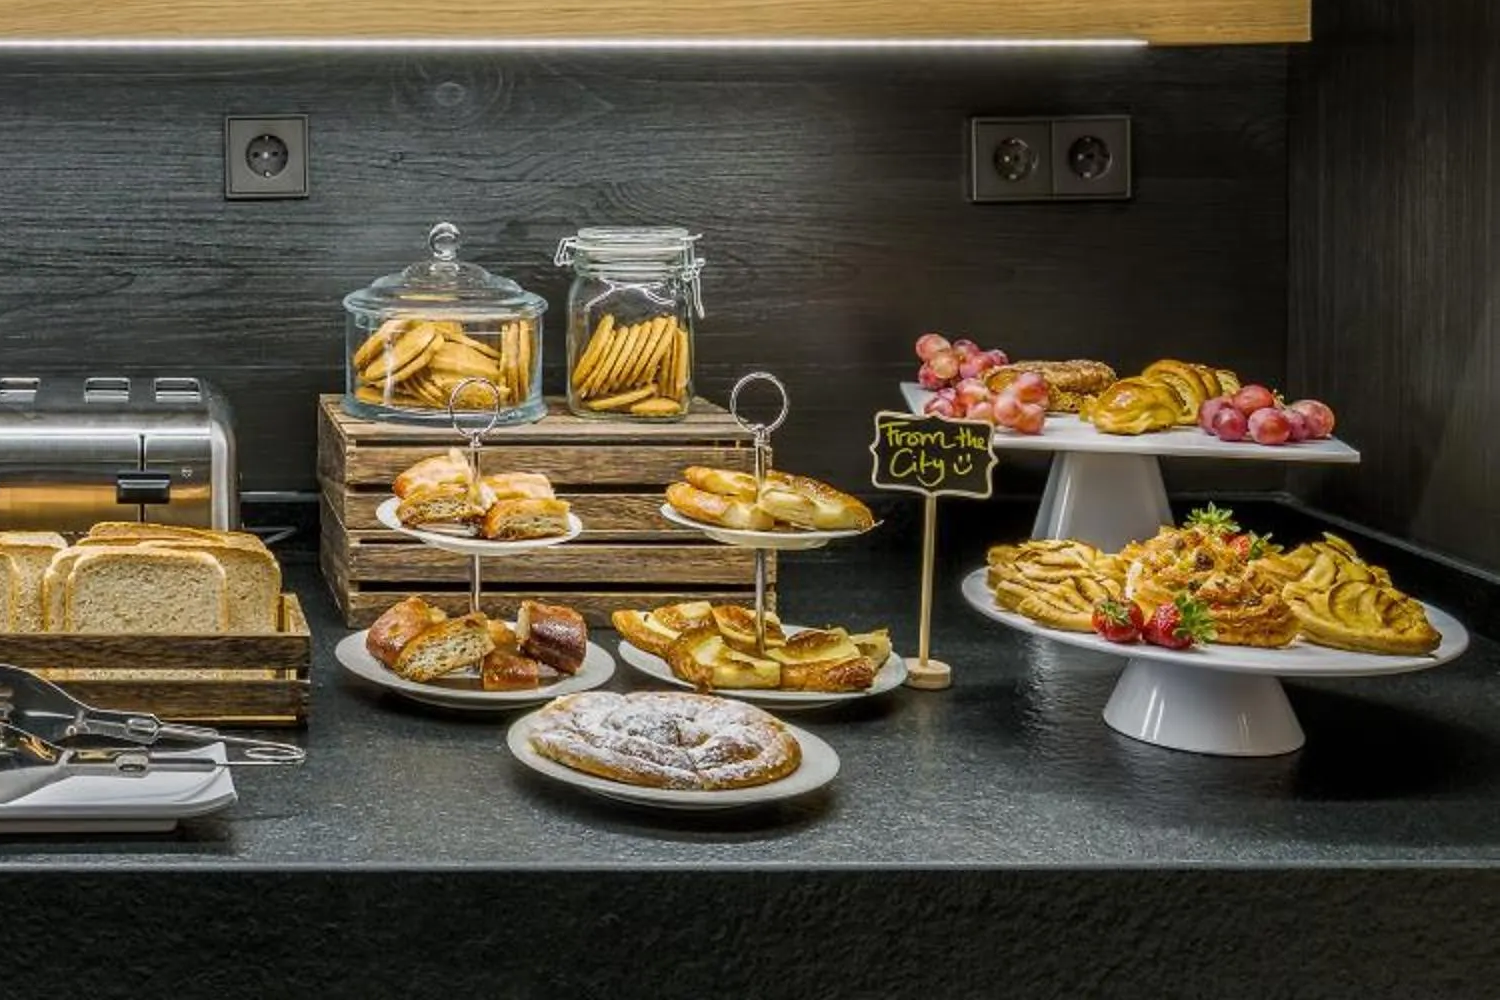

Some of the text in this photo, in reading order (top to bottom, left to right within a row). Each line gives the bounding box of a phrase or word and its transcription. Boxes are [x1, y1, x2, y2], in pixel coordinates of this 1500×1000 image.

[879, 421, 988, 450] From the
[890, 448, 945, 487] City
